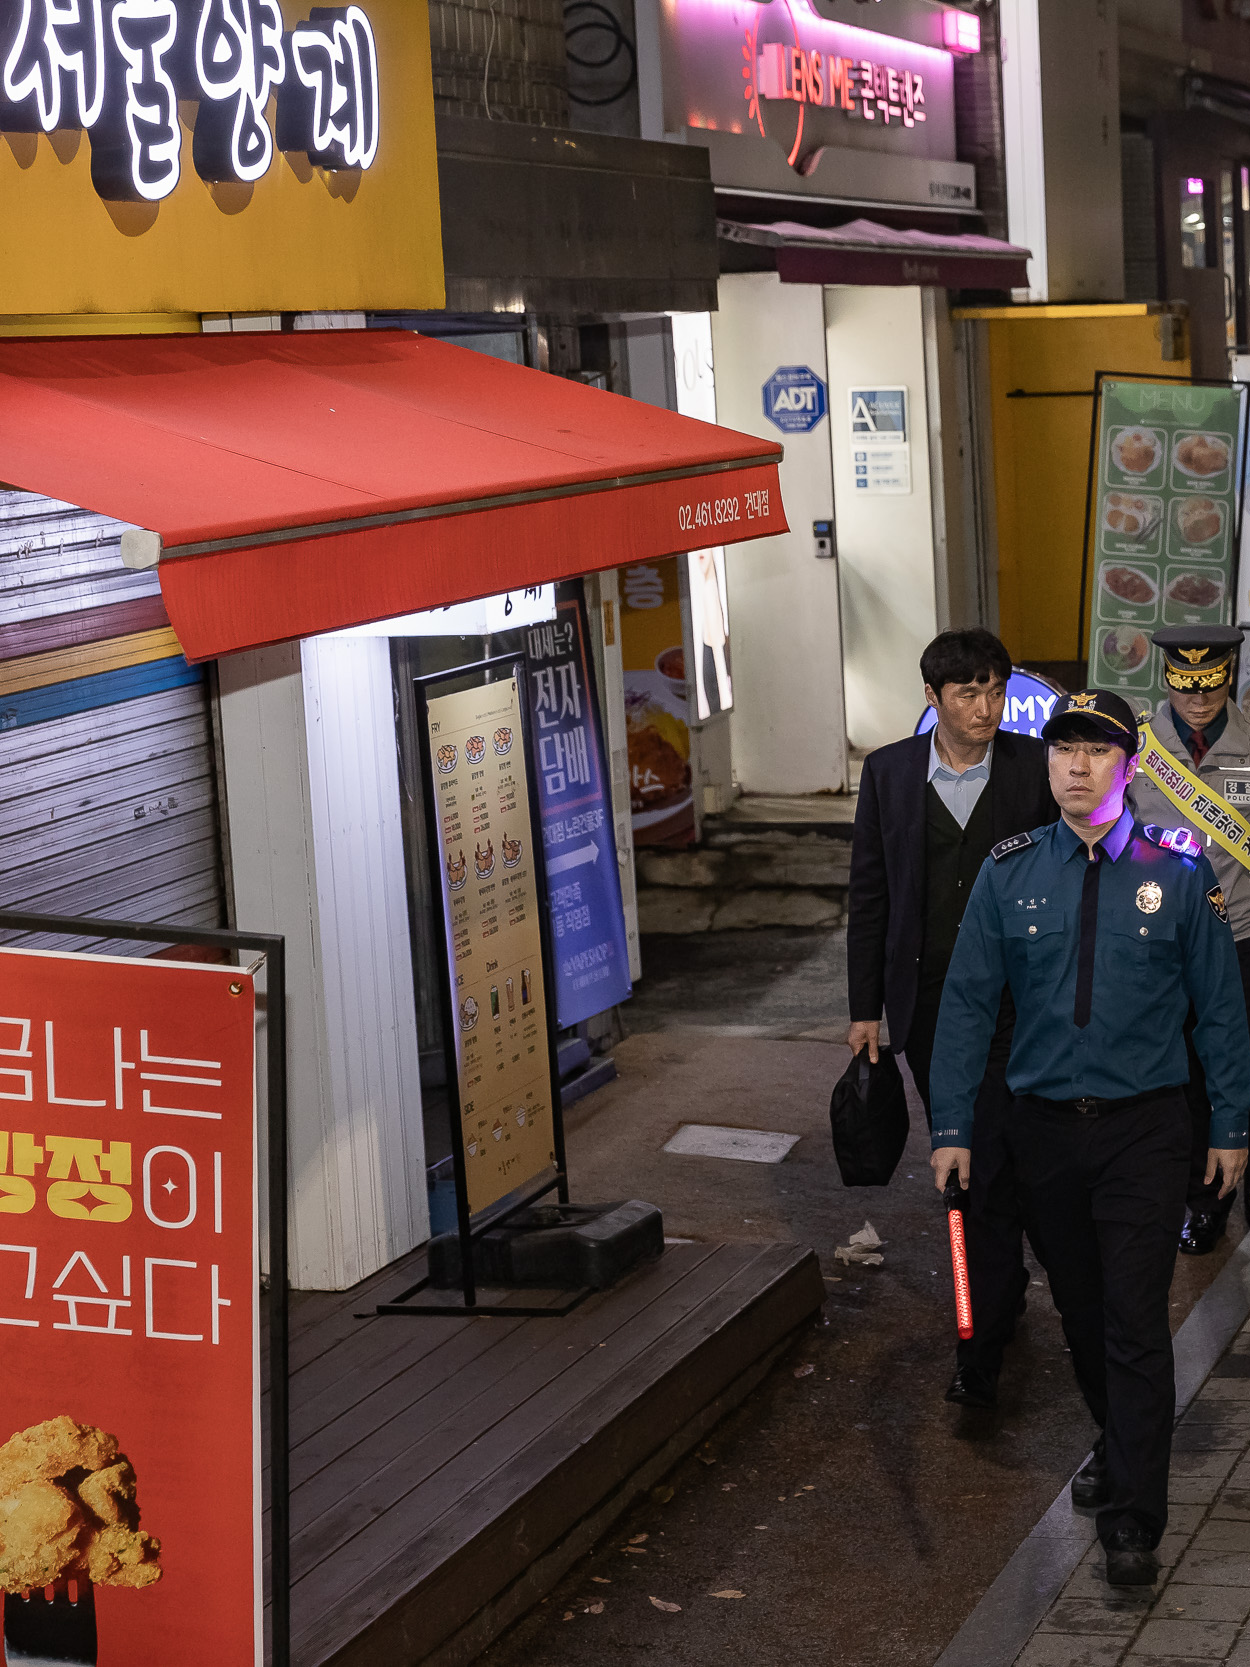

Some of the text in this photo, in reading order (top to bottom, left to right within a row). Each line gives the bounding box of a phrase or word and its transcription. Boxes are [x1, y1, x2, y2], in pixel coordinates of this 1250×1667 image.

[781, 47, 824, 106] LENS
[829, 55, 856, 110] ME
[773, 387, 816, 411] ADT
[678, 489, 770, 531] 02.461.8292 건대점
[527, 621, 574, 661] 대세는?
[532, 661, 582, 729] 전자
[431, 721, 441, 735] FRY
[538, 725, 591, 795] 담배
[486, 960, 498, 973] Drink
